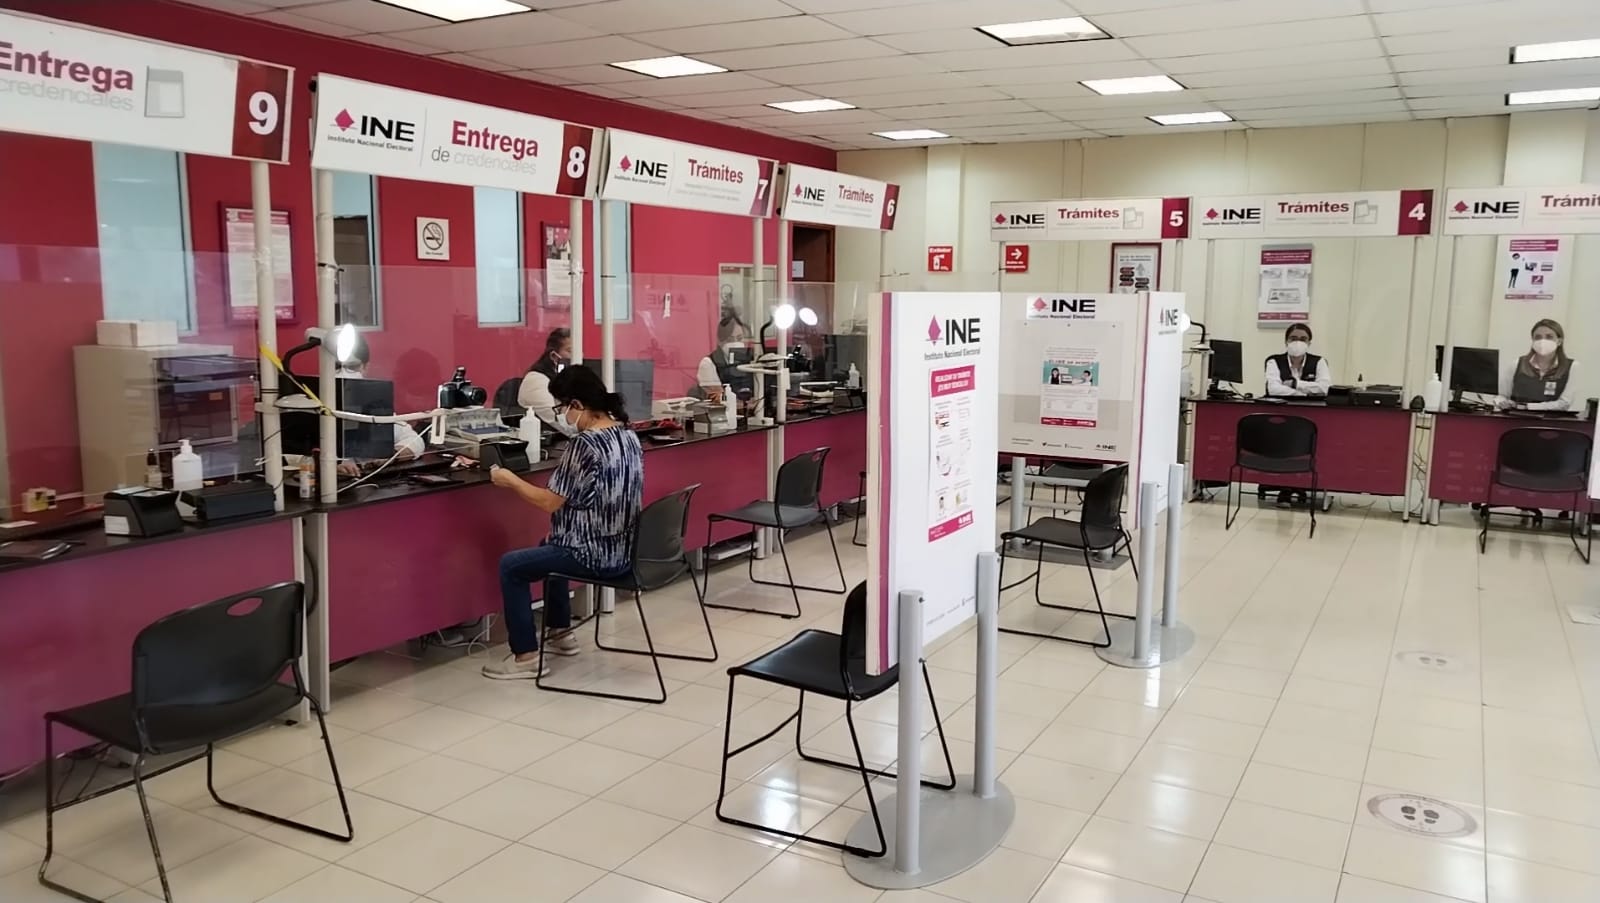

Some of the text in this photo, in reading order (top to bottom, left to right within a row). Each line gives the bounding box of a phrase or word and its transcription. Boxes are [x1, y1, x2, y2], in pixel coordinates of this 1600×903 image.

[249, 91, 279, 135] 9
[360, 115, 415, 142] INE
[451, 120, 539, 160] Entrega
[431, 146, 450, 162] de
[567, 146, 585, 179] 8
[634, 159, 668, 179] INE
[688, 158, 744, 184] Trámites
[757, 179, 769, 200] 7
[803, 186, 826, 202] INE
[838, 184, 874, 204] Trámites
[886, 199, 896, 217] 6
[1057, 208, 1120, 219] Trámites
[1223, 208, 1261, 220] INE
[1277, 201, 1350, 214] Trámites
[1408, 203, 1426, 221] 4
[1473, 201, 1520, 214] INE
[1010, 213, 1045, 225] INE
[1169, 210, 1184, 227] 5
[1051, 299, 1096, 313] INE
[1165, 309, 1178, 327] INE
[945, 318, 981, 346] INE
